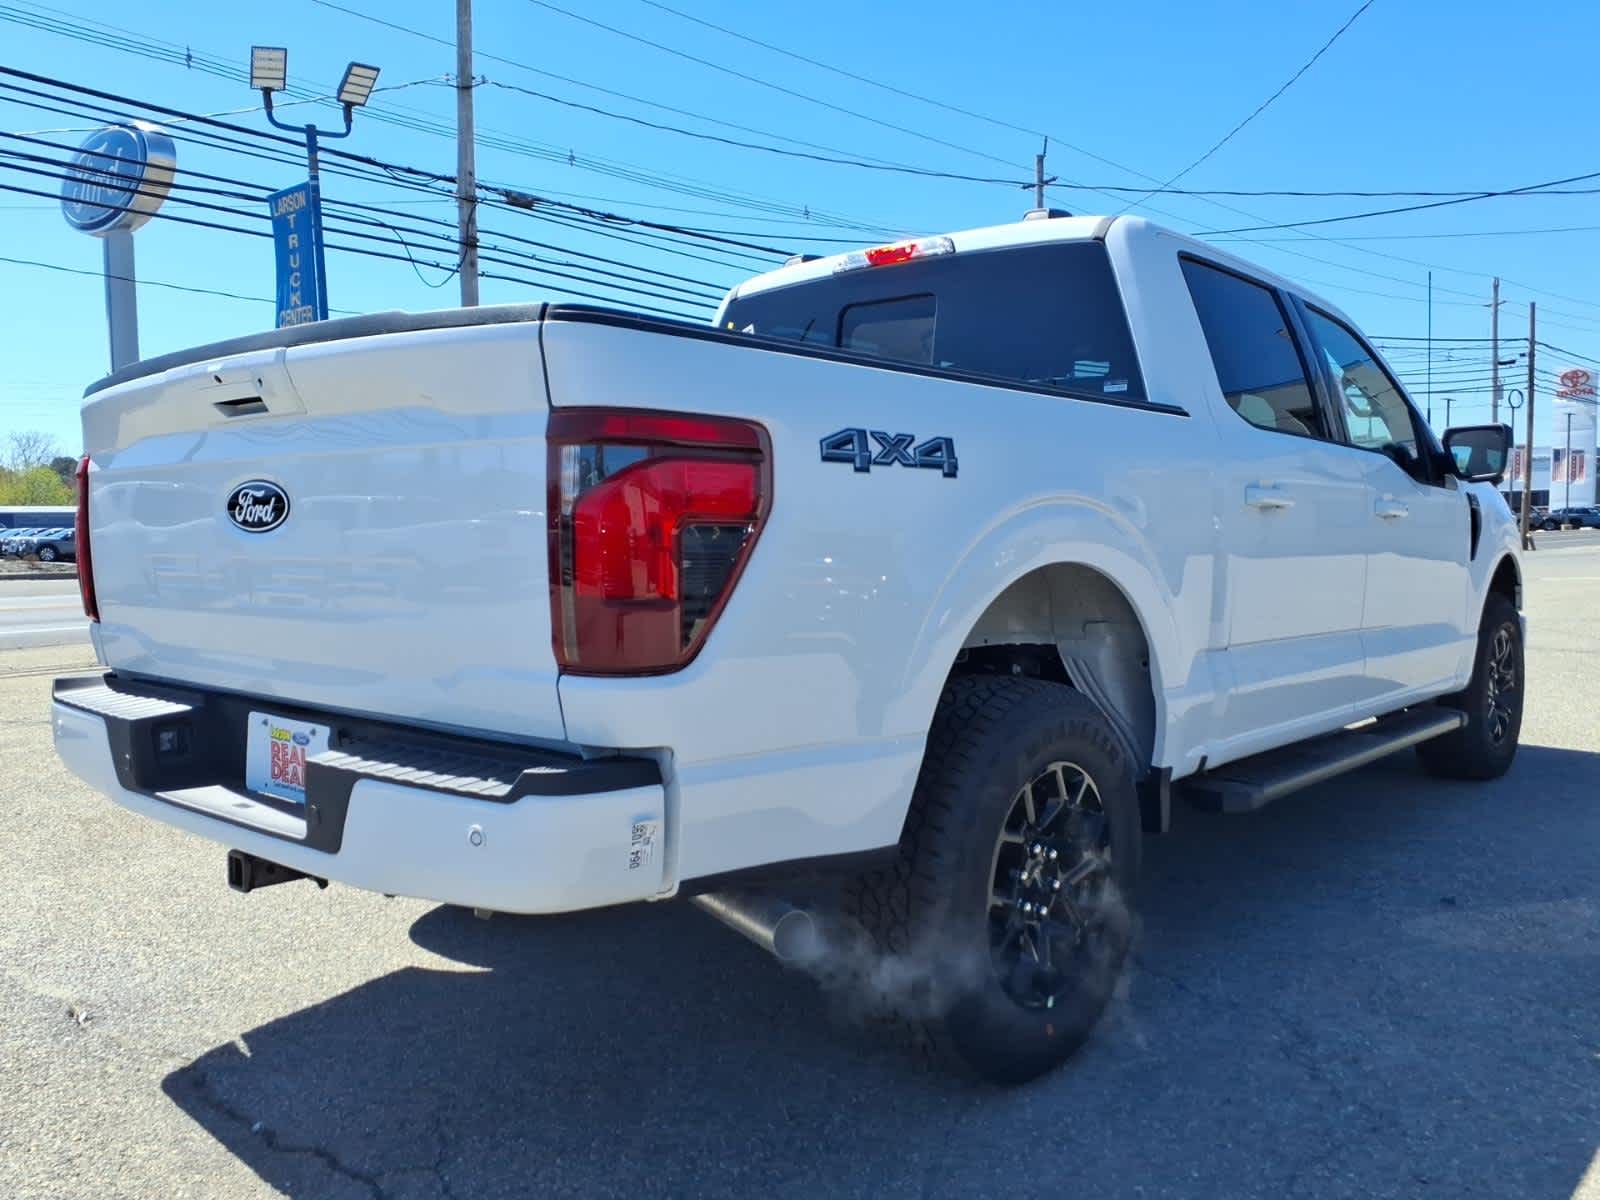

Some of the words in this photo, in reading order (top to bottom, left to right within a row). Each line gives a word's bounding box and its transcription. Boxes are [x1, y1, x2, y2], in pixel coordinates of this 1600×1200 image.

[272, 190, 307, 217] LARSON
[287, 213, 302, 306] TRUCK
[235, 489, 275, 522] Ford
